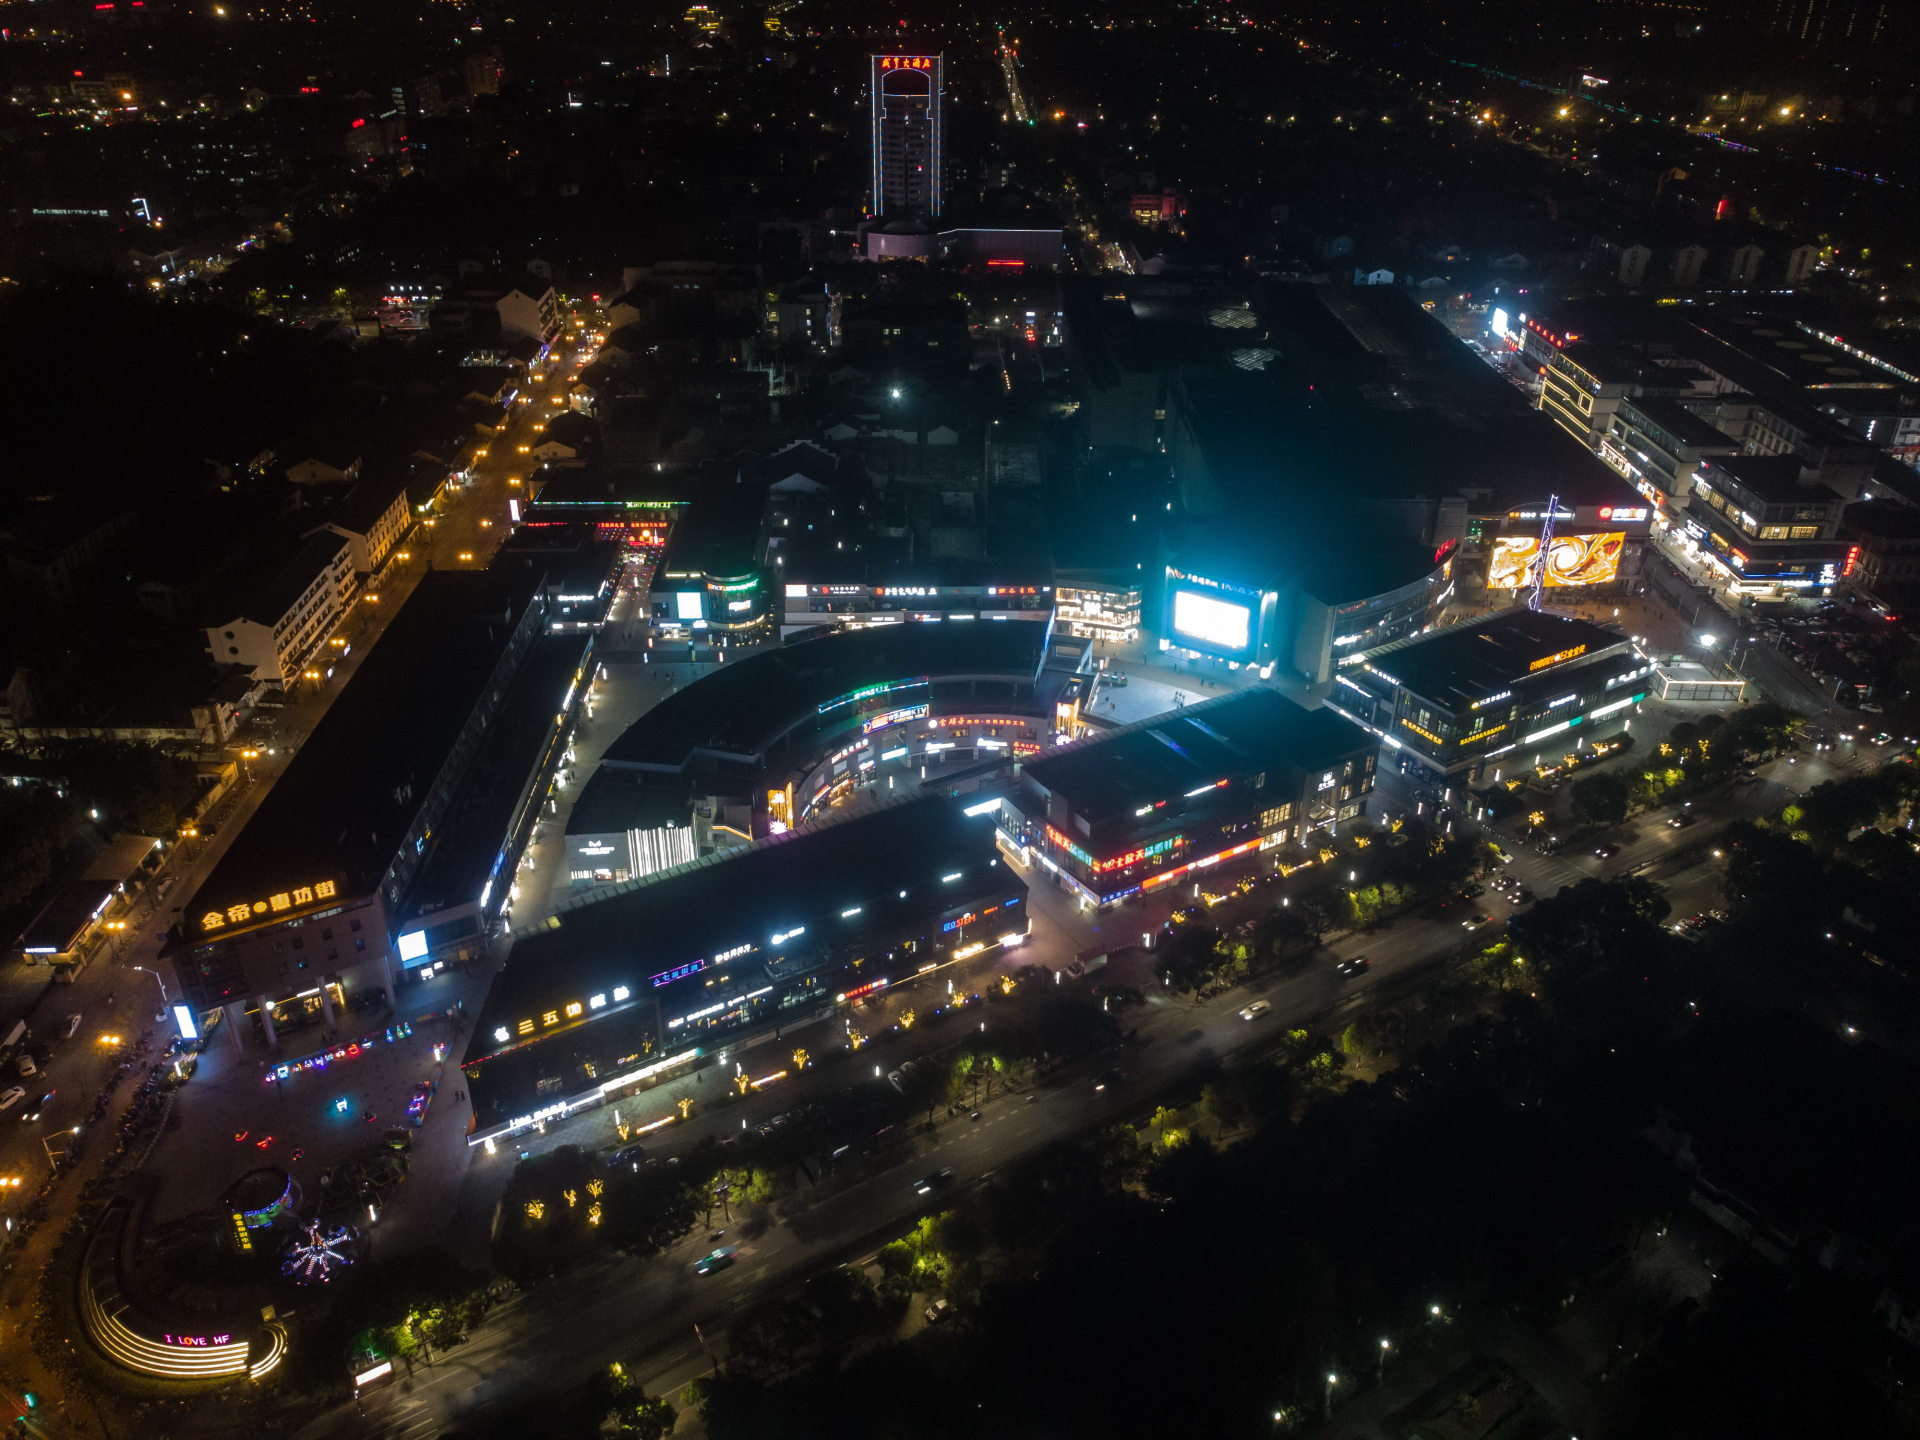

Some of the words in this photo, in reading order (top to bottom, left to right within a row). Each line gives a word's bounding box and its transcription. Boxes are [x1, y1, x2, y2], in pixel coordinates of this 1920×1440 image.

[164, 1334, 173, 1344] I
[178, 1336, 207, 1346] LOVE
[213, 1334, 230, 1345] HF
